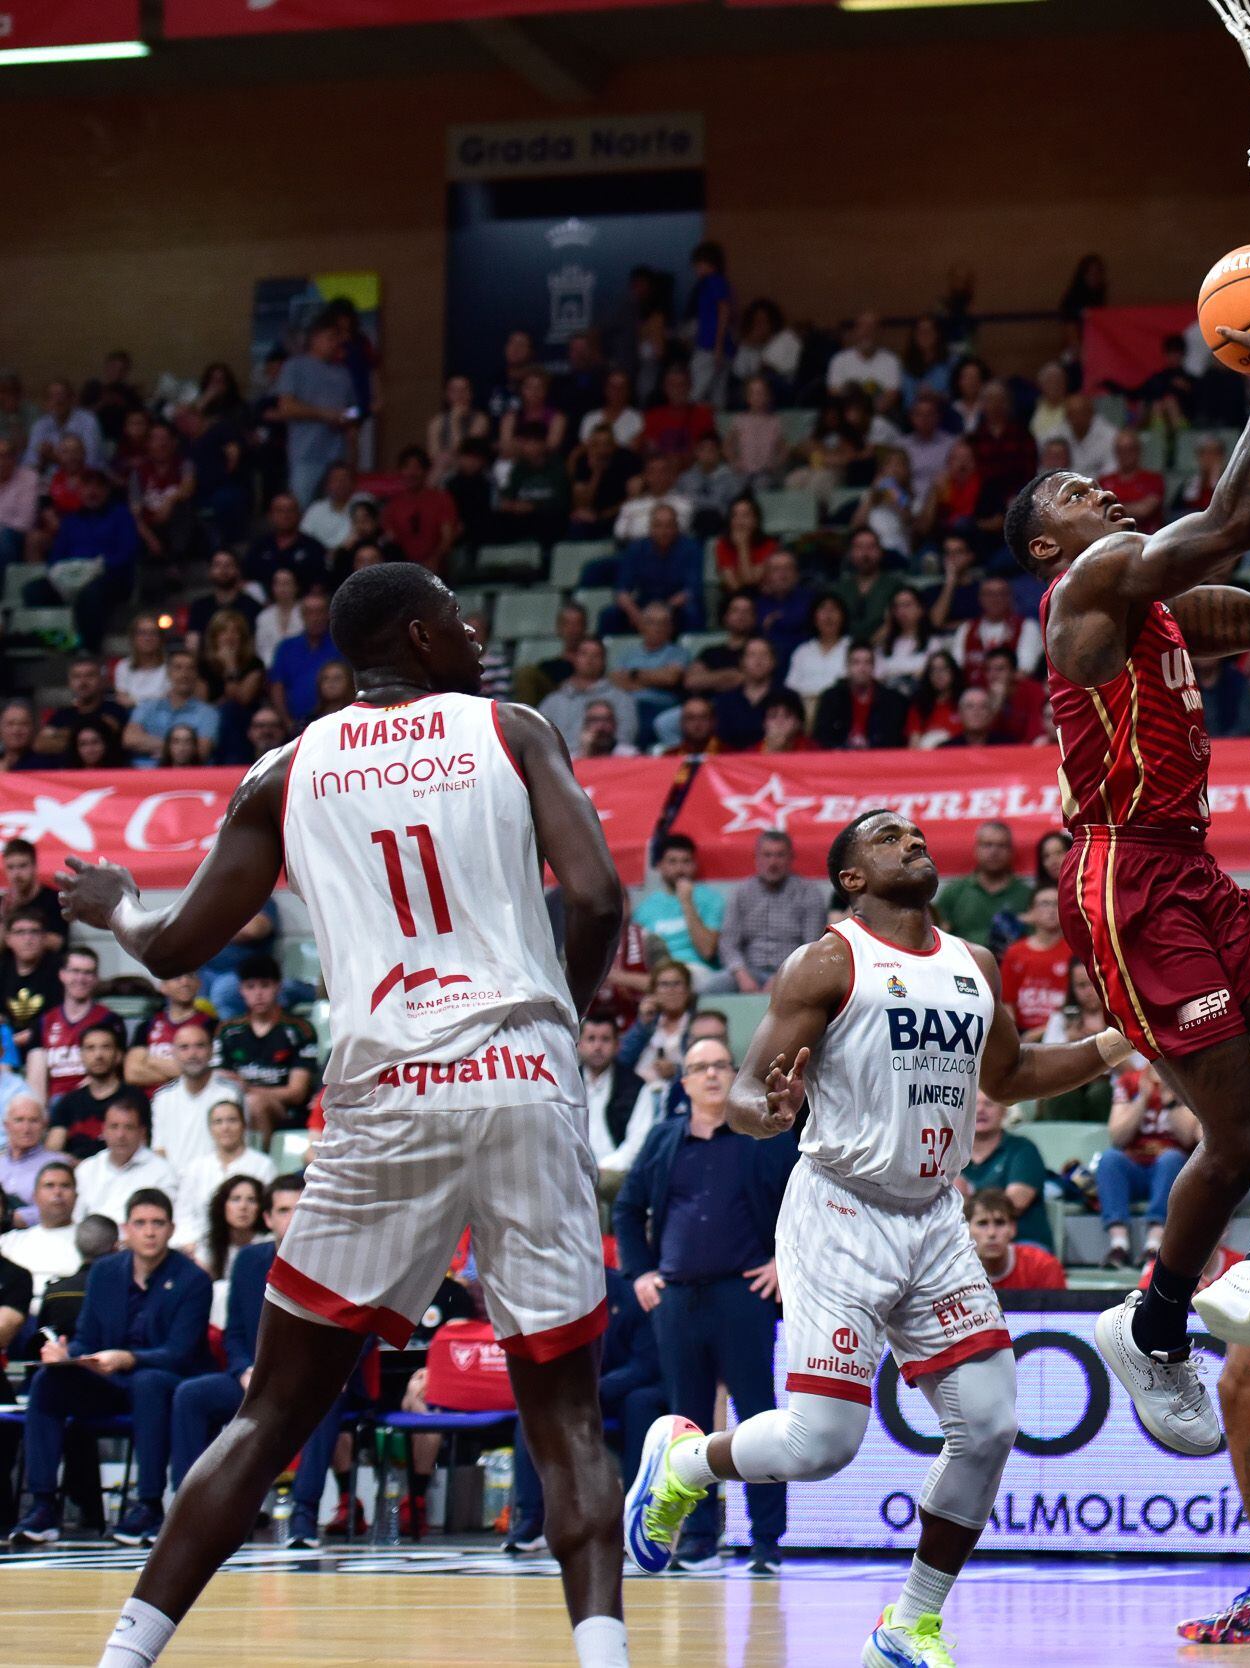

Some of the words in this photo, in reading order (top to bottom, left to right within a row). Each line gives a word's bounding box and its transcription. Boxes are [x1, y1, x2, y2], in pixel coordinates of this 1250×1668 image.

[459, 133, 575, 166] Grada
[591, 128, 692, 157] Norte
[339, 711, 445, 750] MASSA
[312, 753, 476, 800] inmoovs
[412, 788, 426, 798] by
[428, 778, 477, 796] AVINENT
[371, 823, 453, 937] 11
[1195, 988, 1231, 1017] ESP
[885, 1007, 984, 1058] BAXI
[1179, 1008, 1228, 1032] SOLUTIONS
[908, 1084, 965, 1111] MANRESA
[919, 1127, 954, 1179] 32
[936, 1302, 973, 1328] ETL
[943, 1312, 998, 1339] GLOBAL
[807, 1356, 870, 1380] unilabor
